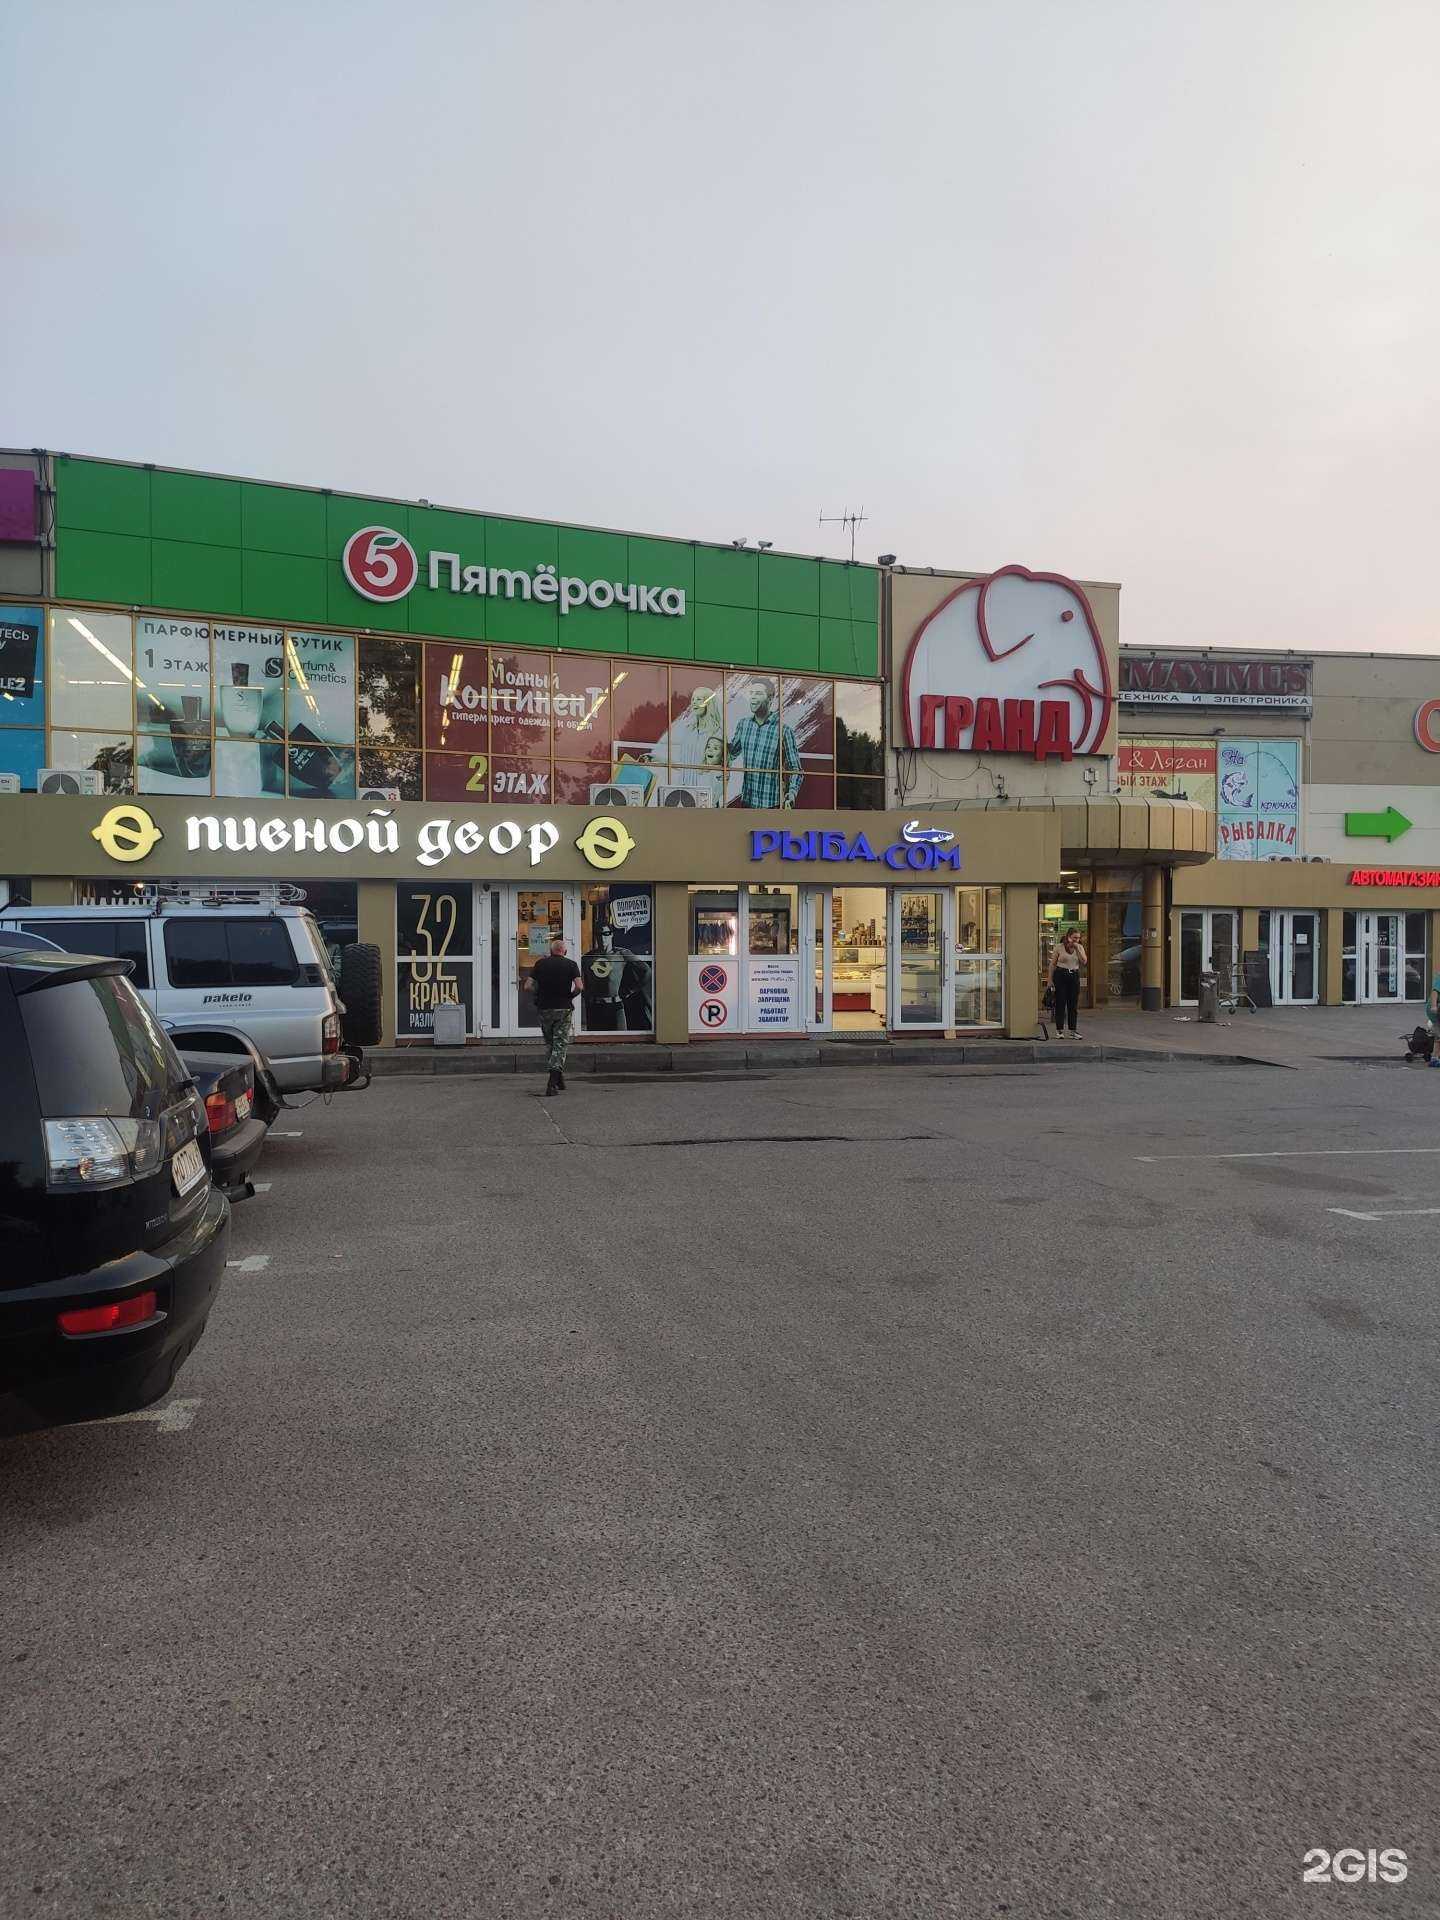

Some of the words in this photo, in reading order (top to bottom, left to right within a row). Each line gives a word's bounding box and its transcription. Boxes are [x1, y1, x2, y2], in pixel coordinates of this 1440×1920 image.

[428, 550, 687, 616] Пятёрочка
[144, 622, 284, 646] ПАРФЮМЕРНЫЙ
[144, 648, 154, 668] 1
[163, 659, 210, 673] ЭТАЖ
[289, 660, 336, 672] rfum&
[288, 669, 347, 684] Csmetics
[489, 660, 560, 690] Модный
[1124, 660, 1307, 693] MAXIMUS
[1192, 695, 1202, 703] И
[1214, 695, 1310, 705] ЭЛЕКТРОНИКА
[920, 694, 1074, 762] ГРАНД
[1150, 750, 1208, 770] Ляган
[465, 755, 488, 792] 2
[493, 771, 549, 795] ЭТАЖ
[1117, 775, 1136, 788] ЫЙ
[1139, 775, 1169, 788] ЭТАЖ
[1220, 820, 1297, 845] РЫБАЛКА
[410, 894, 458, 982] 32
